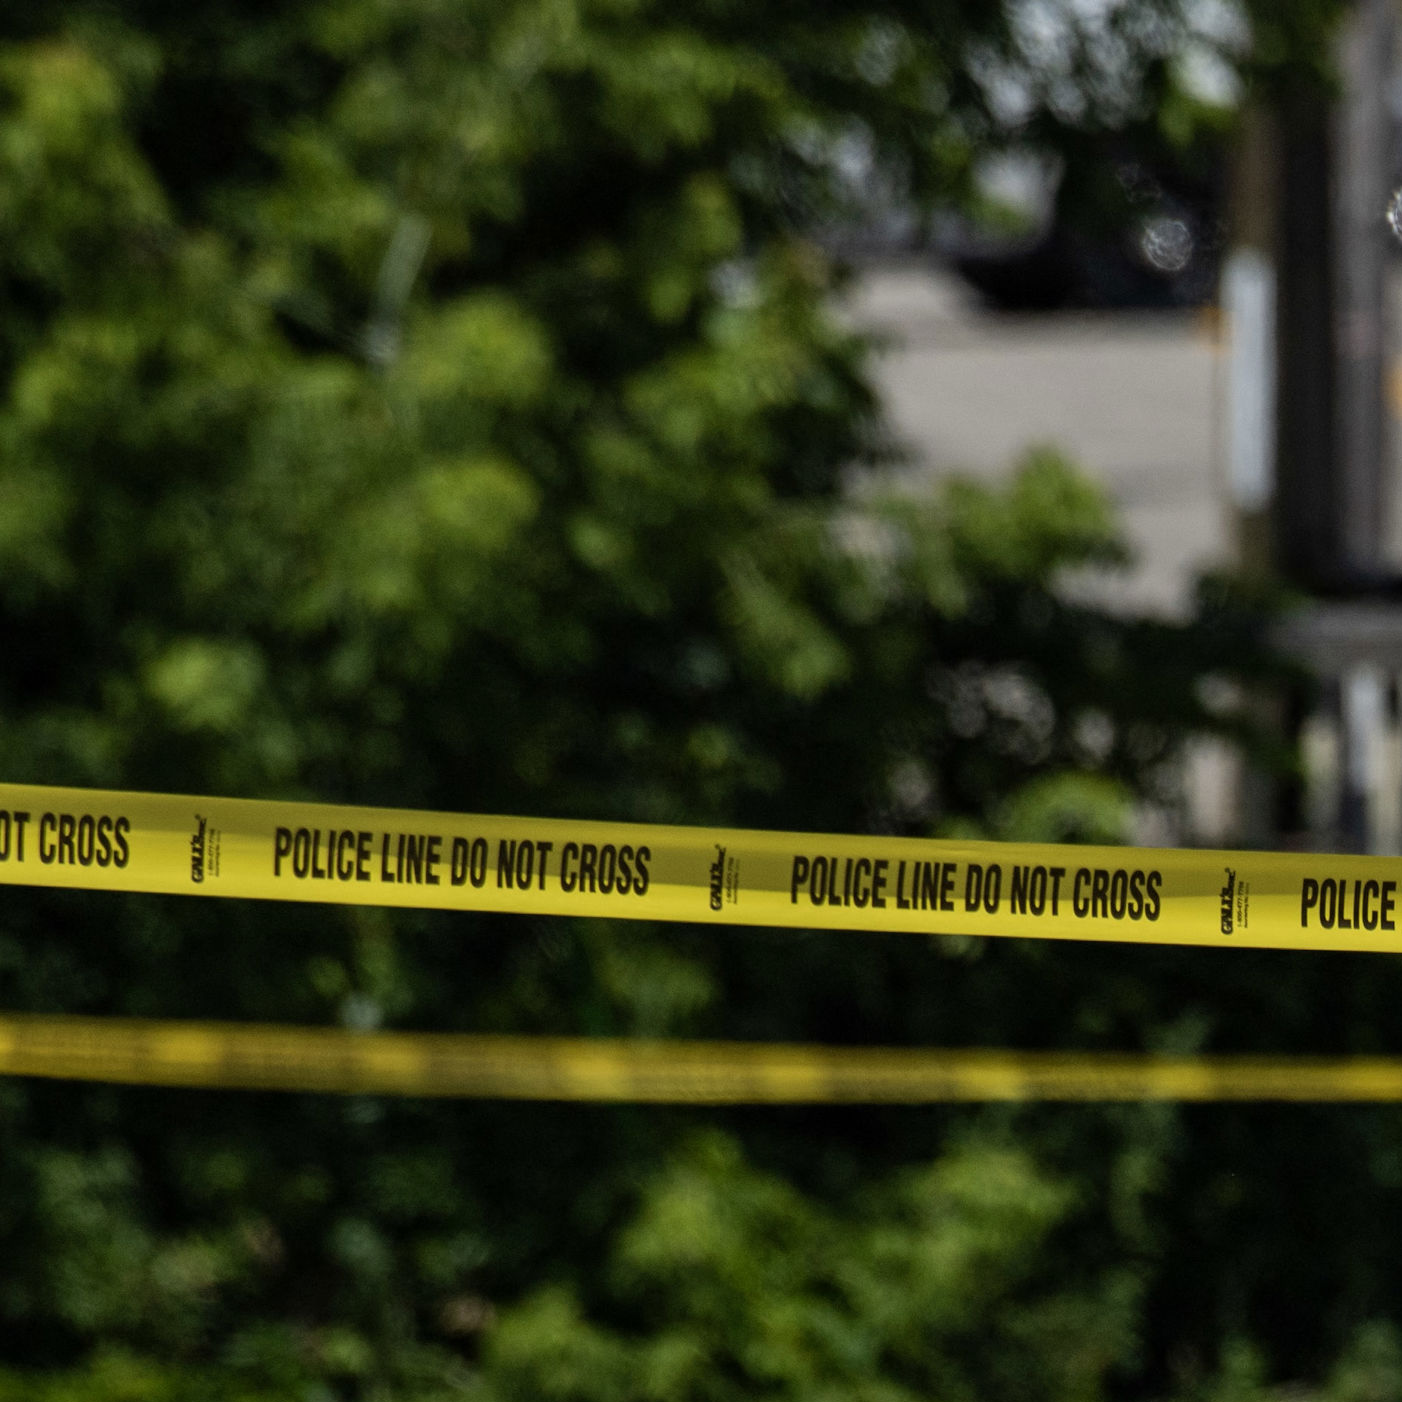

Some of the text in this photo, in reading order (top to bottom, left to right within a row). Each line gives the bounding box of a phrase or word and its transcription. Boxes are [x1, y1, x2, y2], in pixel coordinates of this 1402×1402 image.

[0, 809, 131, 869] OT CROSS
[273, 826, 374, 882] POLICE
[380, 832, 443, 886] LINE
[450, 836, 489, 889] DO
[496, 839, 554, 891] NOT
[559, 841, 652, 897] CROSS
[790, 855, 890, 909] POLICE
[895, 860, 958, 912] LINE
[964, 863, 1003, 915] DO
[1010, 865, 1067, 917] NOT
[1072, 867, 1163, 922] CROSS
[1300, 877, 1397, 932] POLICE
